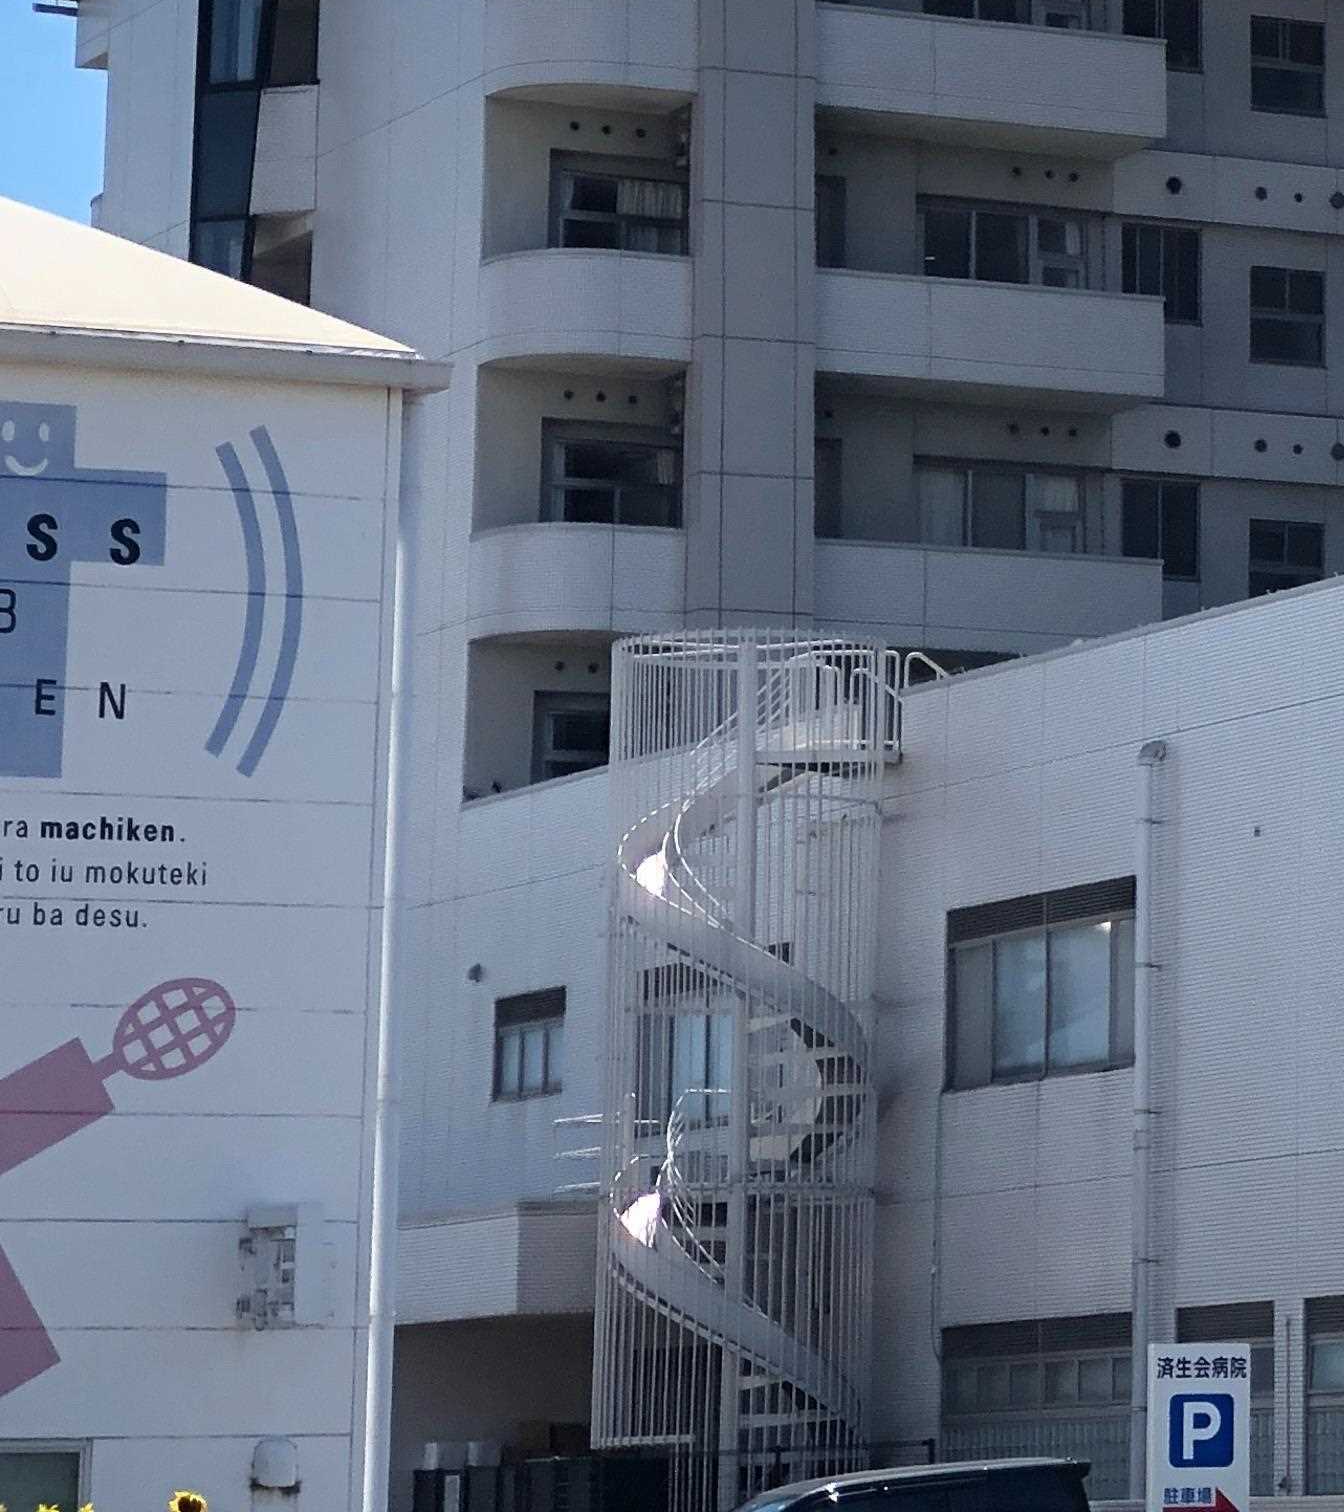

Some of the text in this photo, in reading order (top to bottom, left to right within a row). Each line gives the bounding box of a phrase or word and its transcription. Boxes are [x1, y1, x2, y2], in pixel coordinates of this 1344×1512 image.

[40, 815, 186, 842] machiken.
[14, 859, 40, 883] to
[51, 857, 74, 883] iu
[85, 861, 208, 886] mokuteki
[0, 901, 149, 928] u ba desu.
[1156, 1356, 1248, 1380] 済生会病院
[1182, 1401, 1222, 1461] P
